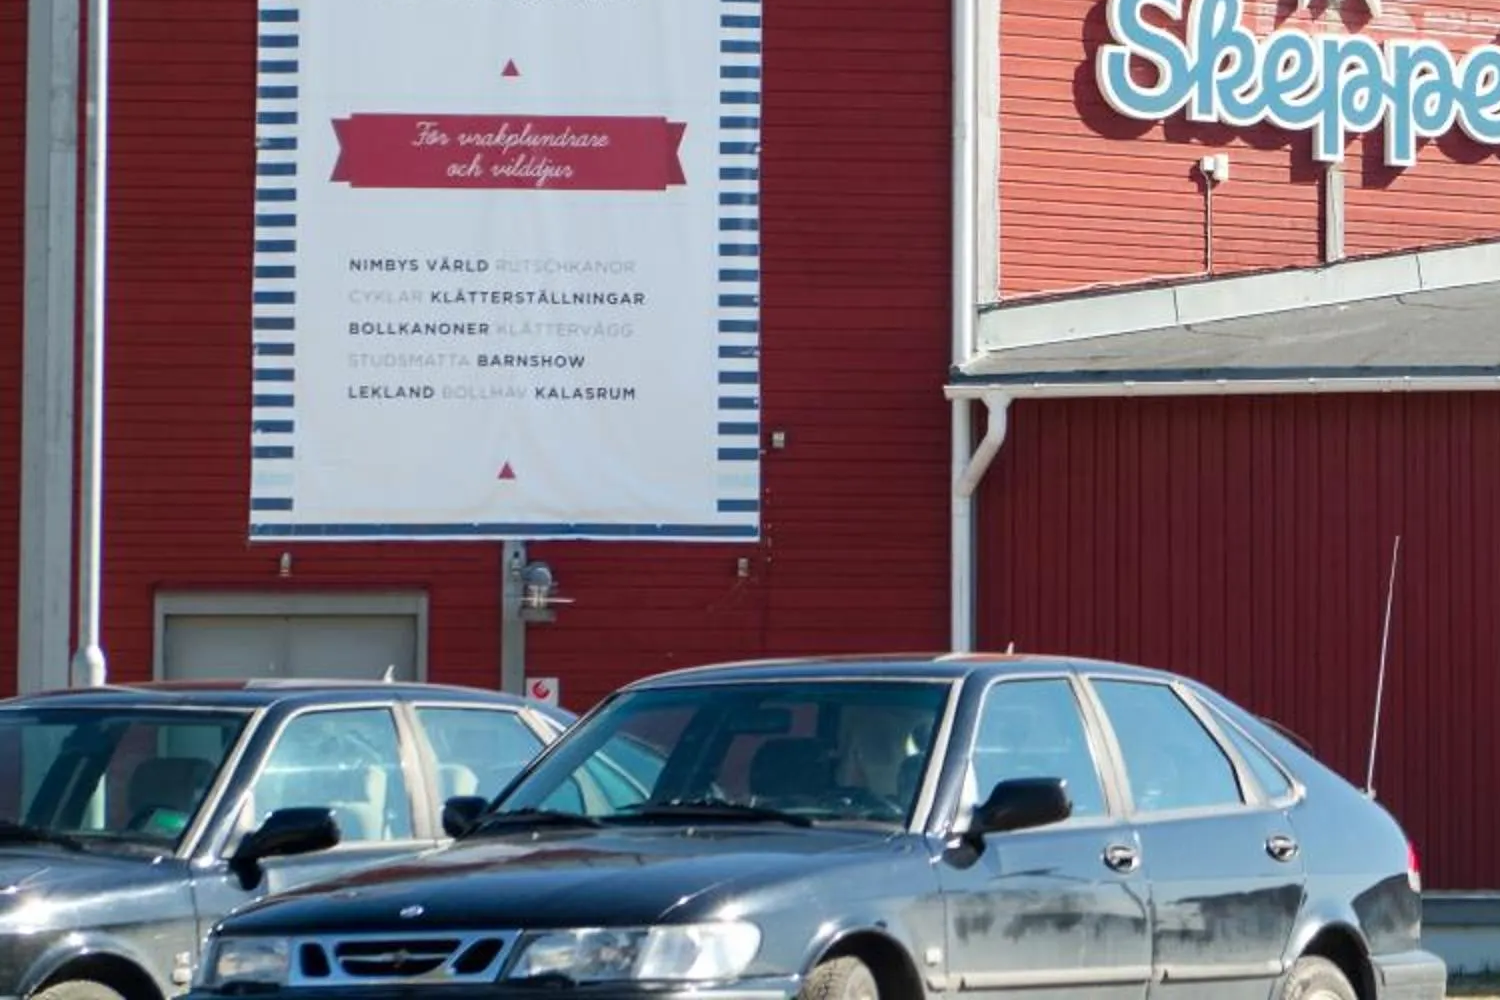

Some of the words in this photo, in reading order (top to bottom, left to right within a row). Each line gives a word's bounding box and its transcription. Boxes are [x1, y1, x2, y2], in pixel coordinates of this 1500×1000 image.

[458, 122, 610, 154] vrakplundrare
[447, 154, 483, 178] och
[491, 154, 573, 188] vilddjur
[349, 258, 420, 272] NIMBYS
[425, 256, 490, 273] VÄRLD
[495, 259, 637, 275] RUTSCHKANOR
[430, 288, 646, 305] KLÄTTERSTÄLLNINGAR
[349, 322, 490, 336] BOLLKANONER
[349, 354, 471, 369] STUDSMATTA
[477, 354, 585, 368] BARNSHOW
[348, 385, 435, 399] LEKLAND
[534, 387, 637, 401] KALASRUM
